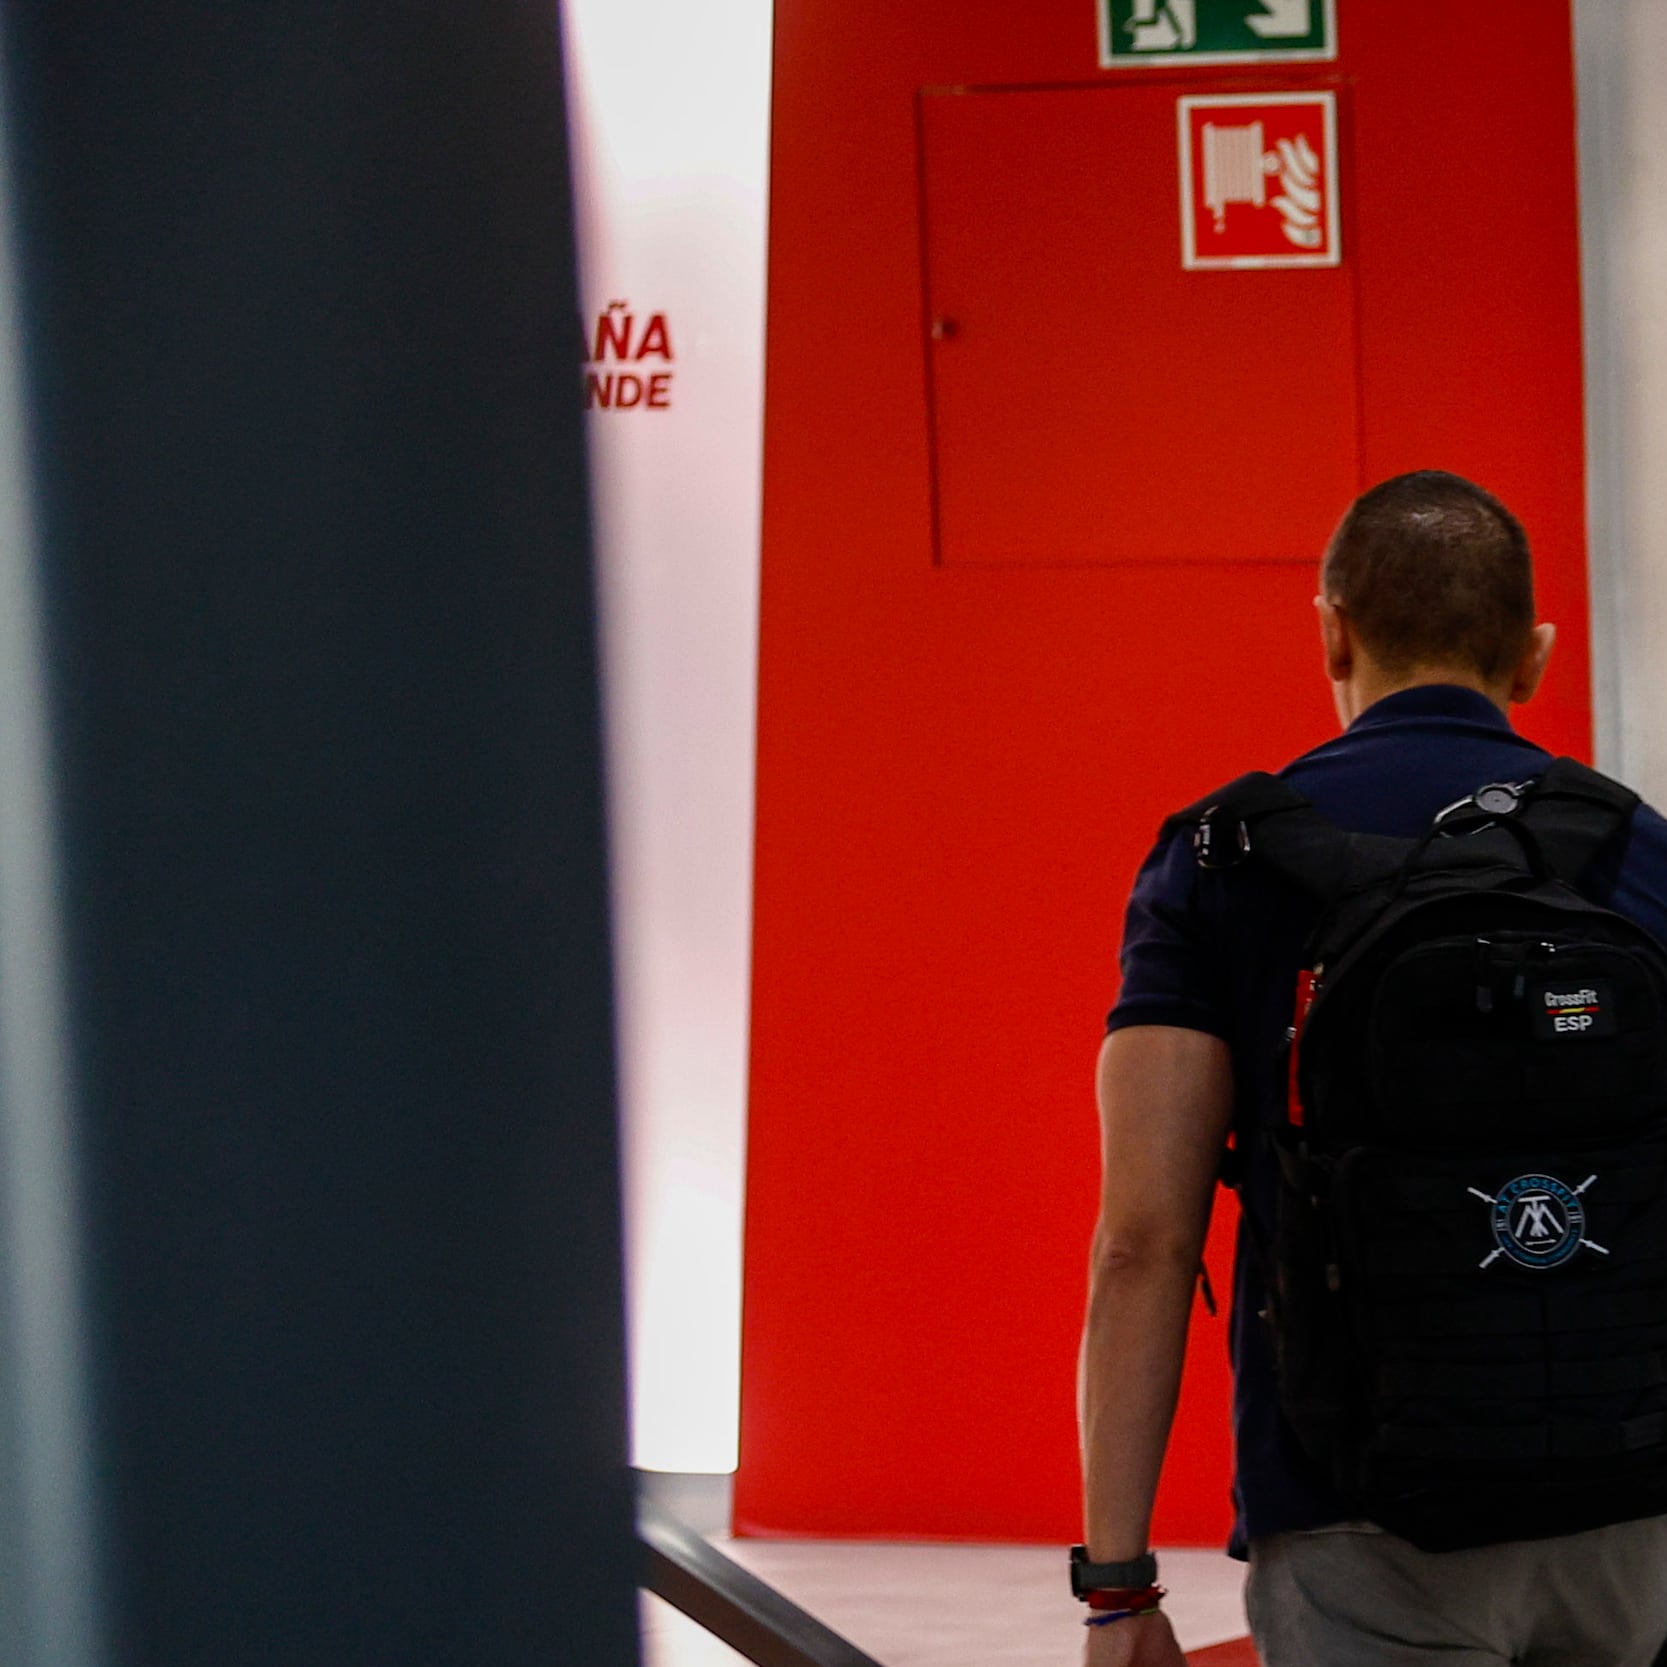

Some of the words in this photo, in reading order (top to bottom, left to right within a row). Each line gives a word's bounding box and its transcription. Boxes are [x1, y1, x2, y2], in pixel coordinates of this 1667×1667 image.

[586, 300, 673, 363] ÑA
[584, 372, 672, 410] NDE
[1544, 988, 1599, 1008] CrossFit
[1554, 1014, 1593, 1032] ESP
